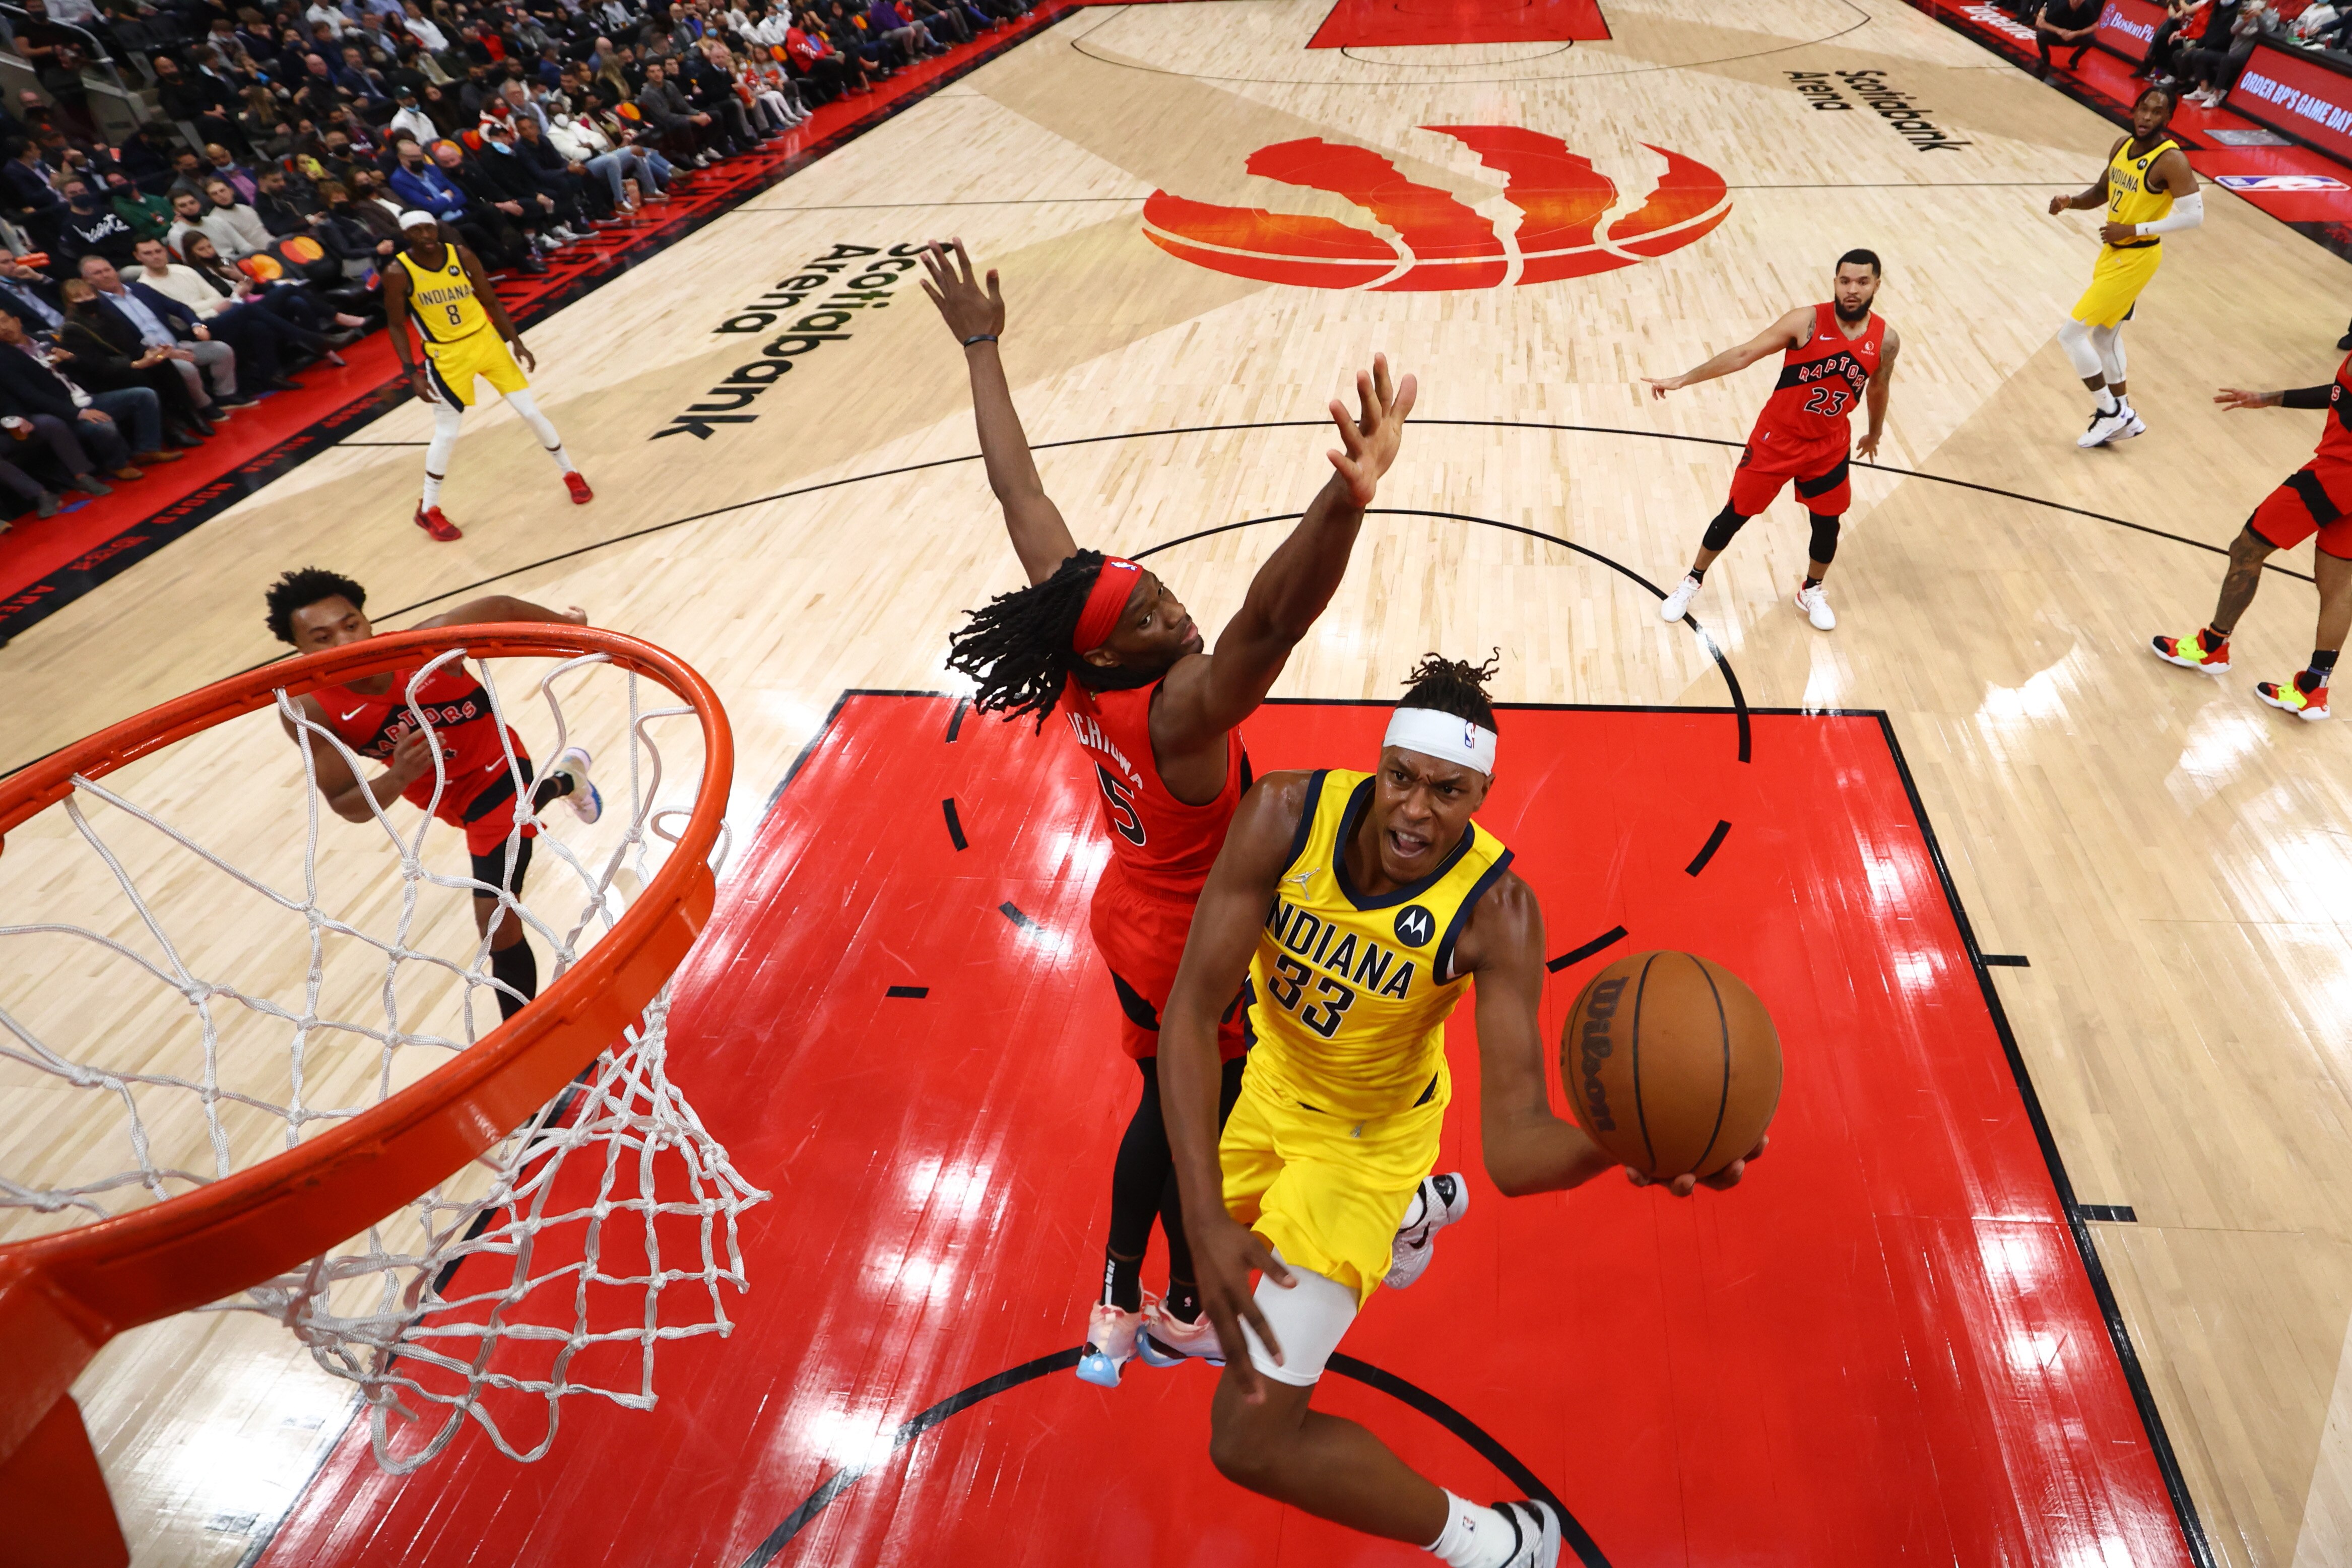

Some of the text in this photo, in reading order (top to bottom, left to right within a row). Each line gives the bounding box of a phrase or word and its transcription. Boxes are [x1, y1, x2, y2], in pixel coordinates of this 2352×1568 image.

[2110, 12, 2142, 39] Boston
[1783, 71, 1853, 110] Arena
[1835, 70, 1974, 151] Scotiabank
[2240, 71, 2352, 133] ORDER BP'S GAME DAY
[2110, 187, 2123, 213] 12
[417, 283, 474, 306] INDIANA
[445, 303, 462, 326] 8
[711, 243, 881, 334] Arena
[647, 241, 955, 440] Scotiabank
[1804, 387, 1849, 417] 23
[1094, 760, 1147, 847] 5
[1265, 893, 1416, 1000] NDIANA
[1267, 953, 1357, 1039] 33
[1581, 976, 1630, 1132] Wilson
